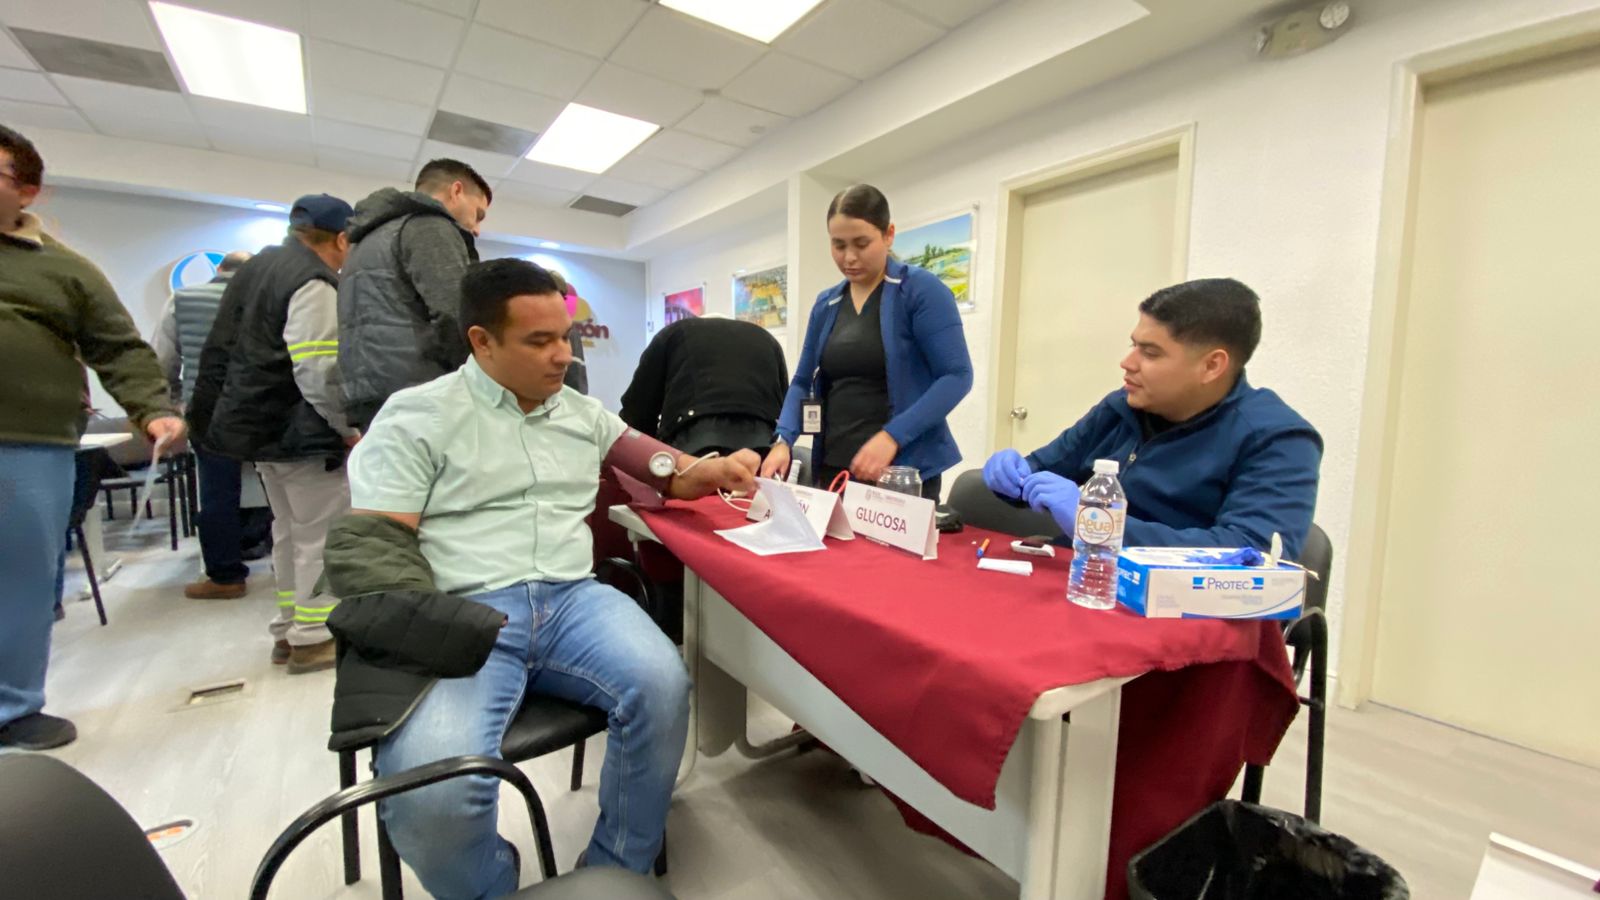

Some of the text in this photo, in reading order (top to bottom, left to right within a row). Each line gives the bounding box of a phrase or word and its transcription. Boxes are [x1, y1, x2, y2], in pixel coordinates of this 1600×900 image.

[856, 507, 907, 534] GLUCOSA
[1078, 514, 1112, 534] Agua
[1207, 577, 1250, 590] PROTEC
